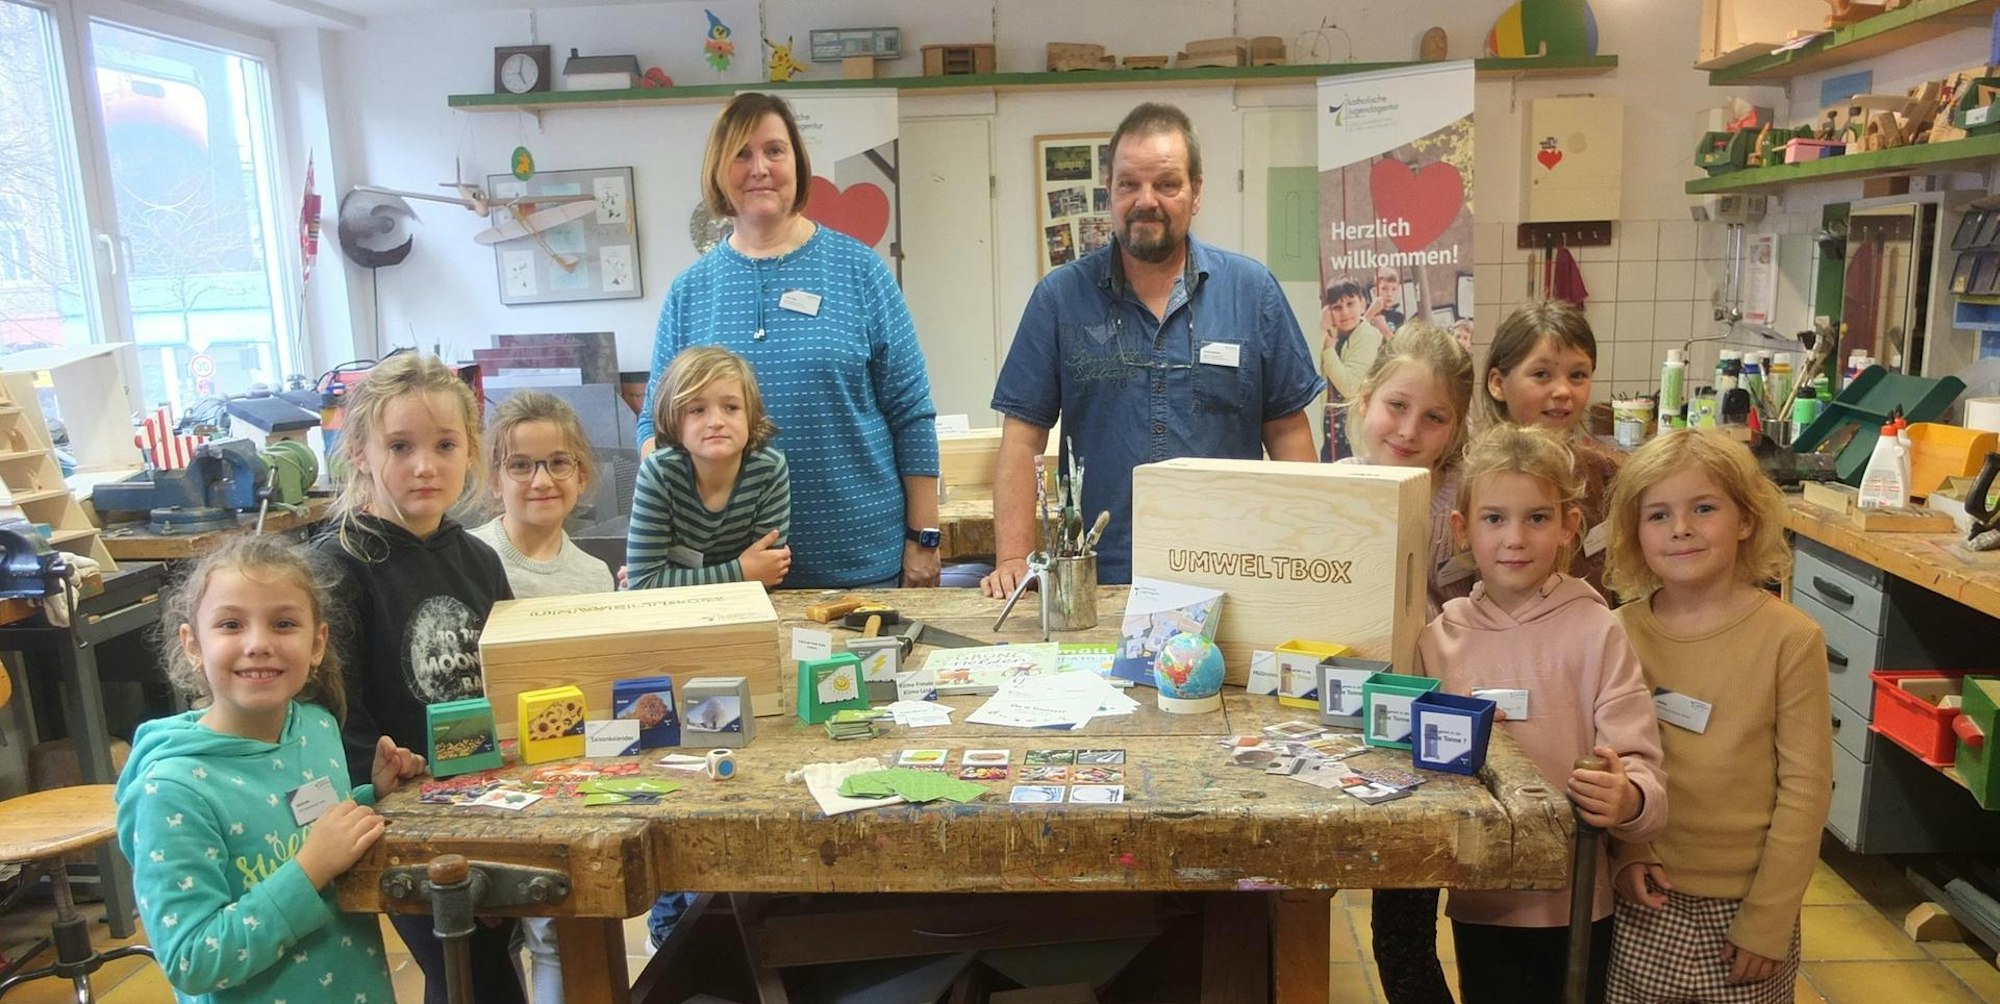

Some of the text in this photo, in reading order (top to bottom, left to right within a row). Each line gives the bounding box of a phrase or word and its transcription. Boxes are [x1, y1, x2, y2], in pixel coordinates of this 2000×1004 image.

[1331, 217, 1411, 241] Herzlich
[1331, 244, 1458, 270] willkommen!
[1168, 549, 1352, 584] UMWELTBOX
[1443, 735, 1462, 743] Tonne
